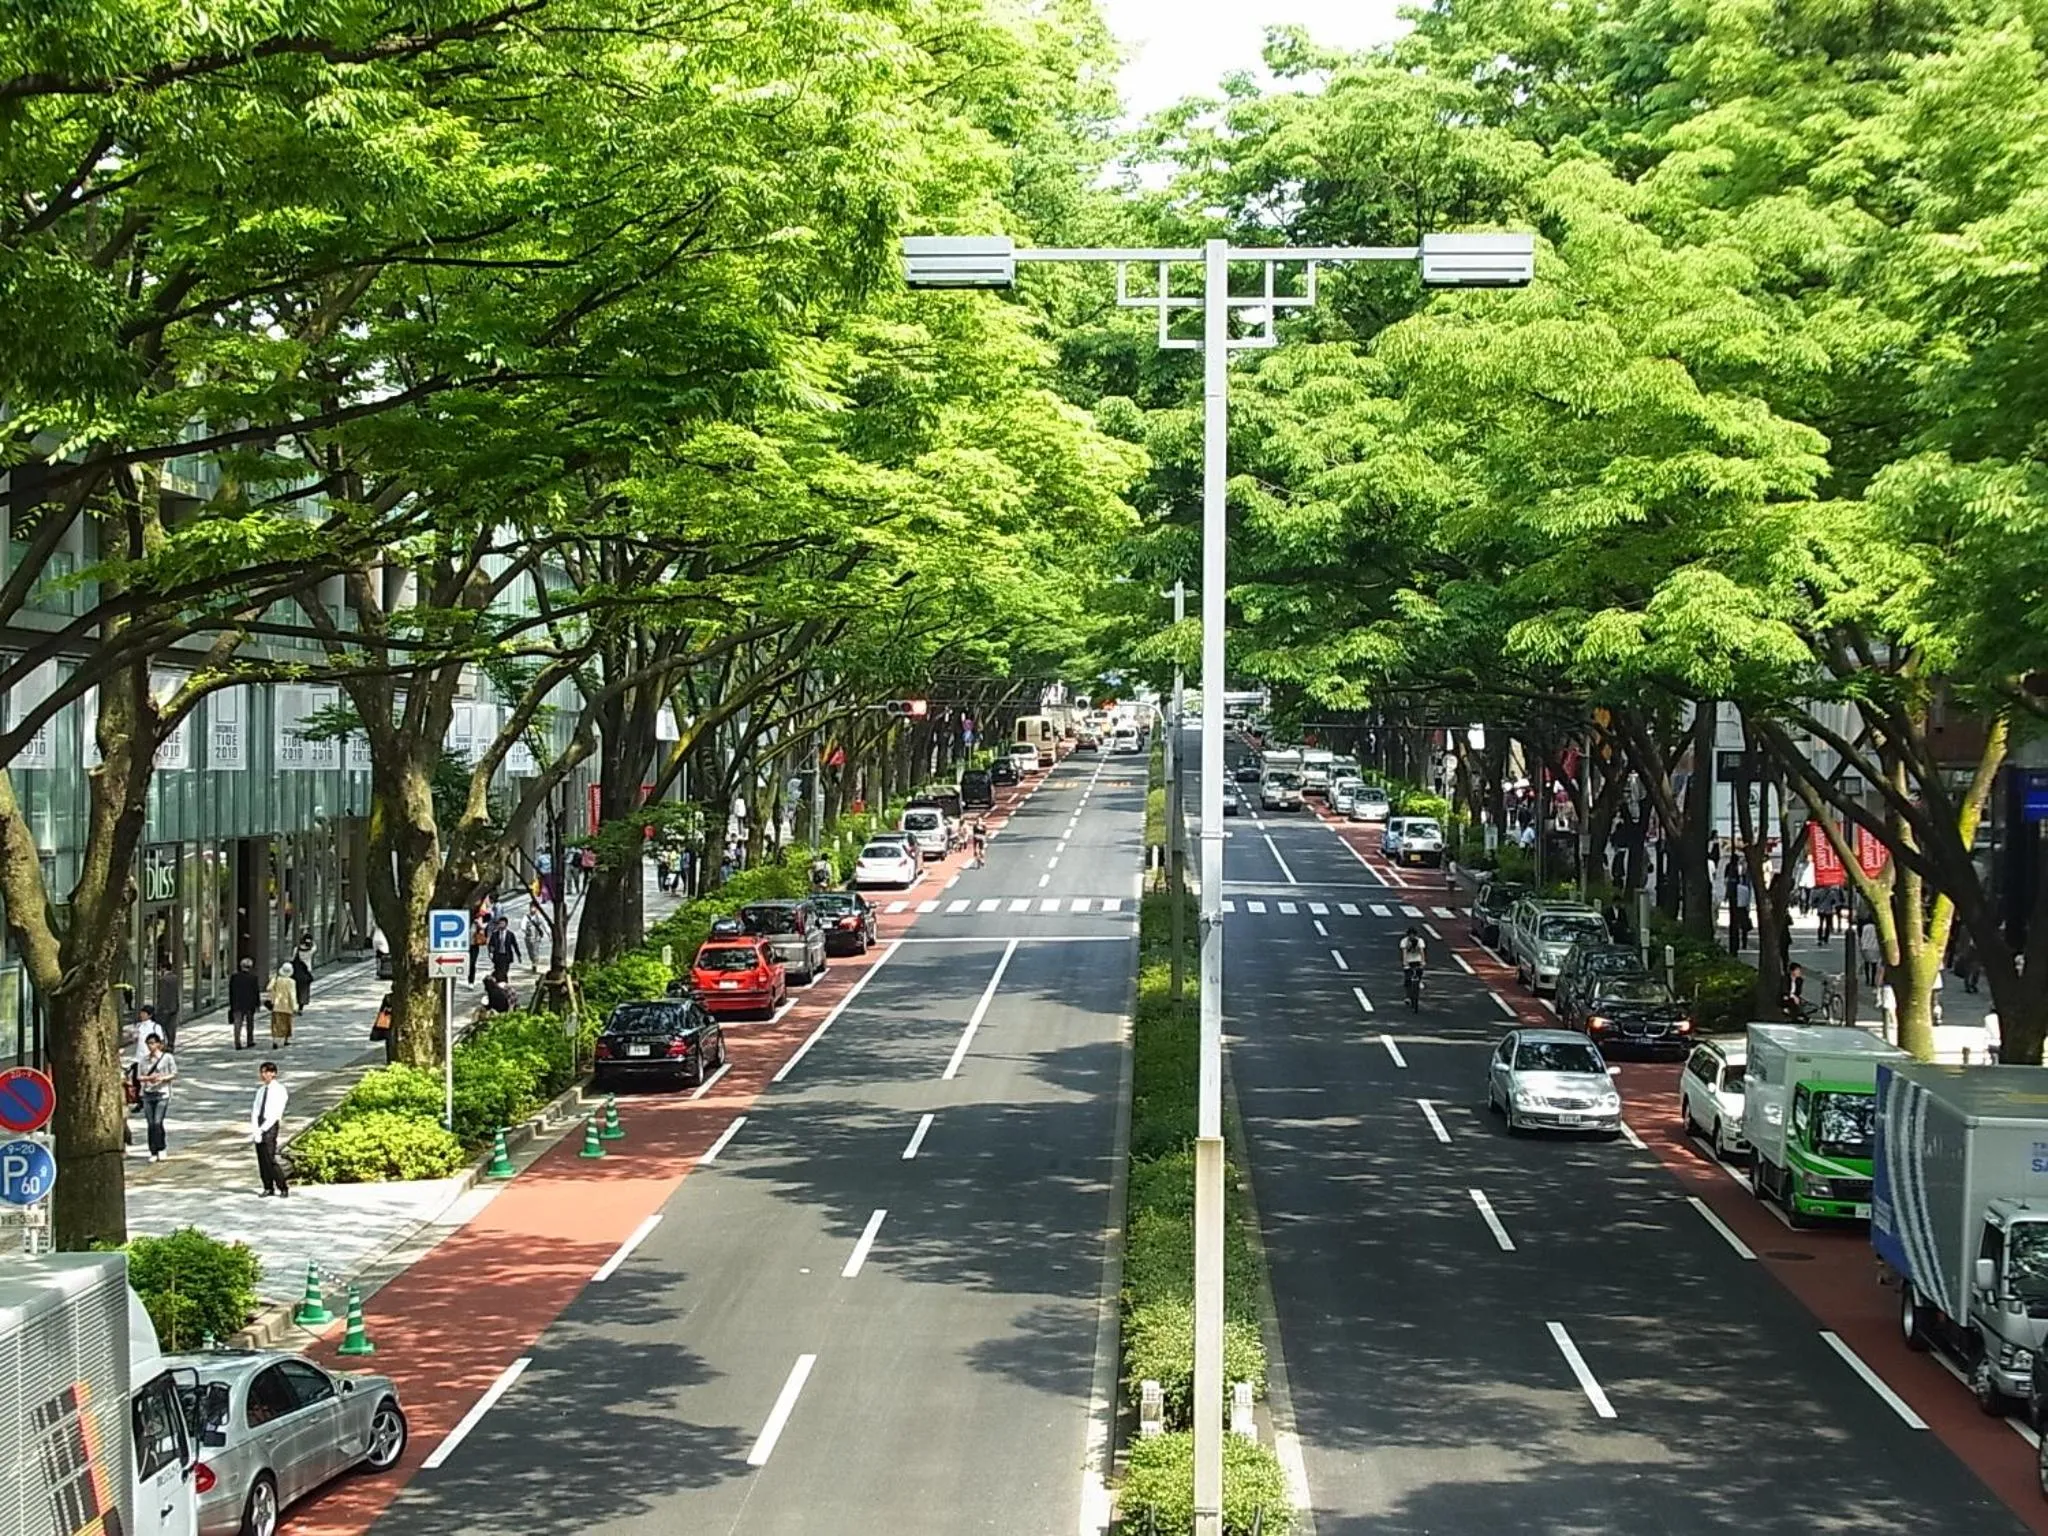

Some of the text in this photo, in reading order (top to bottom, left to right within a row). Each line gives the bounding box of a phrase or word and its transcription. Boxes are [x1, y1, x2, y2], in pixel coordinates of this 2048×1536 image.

[215, 747, 238, 759] 2010
[434, 914, 465, 948] P
[8, 1144, 36, 1155] 9-20
[3, 1155, 29, 1196] P
